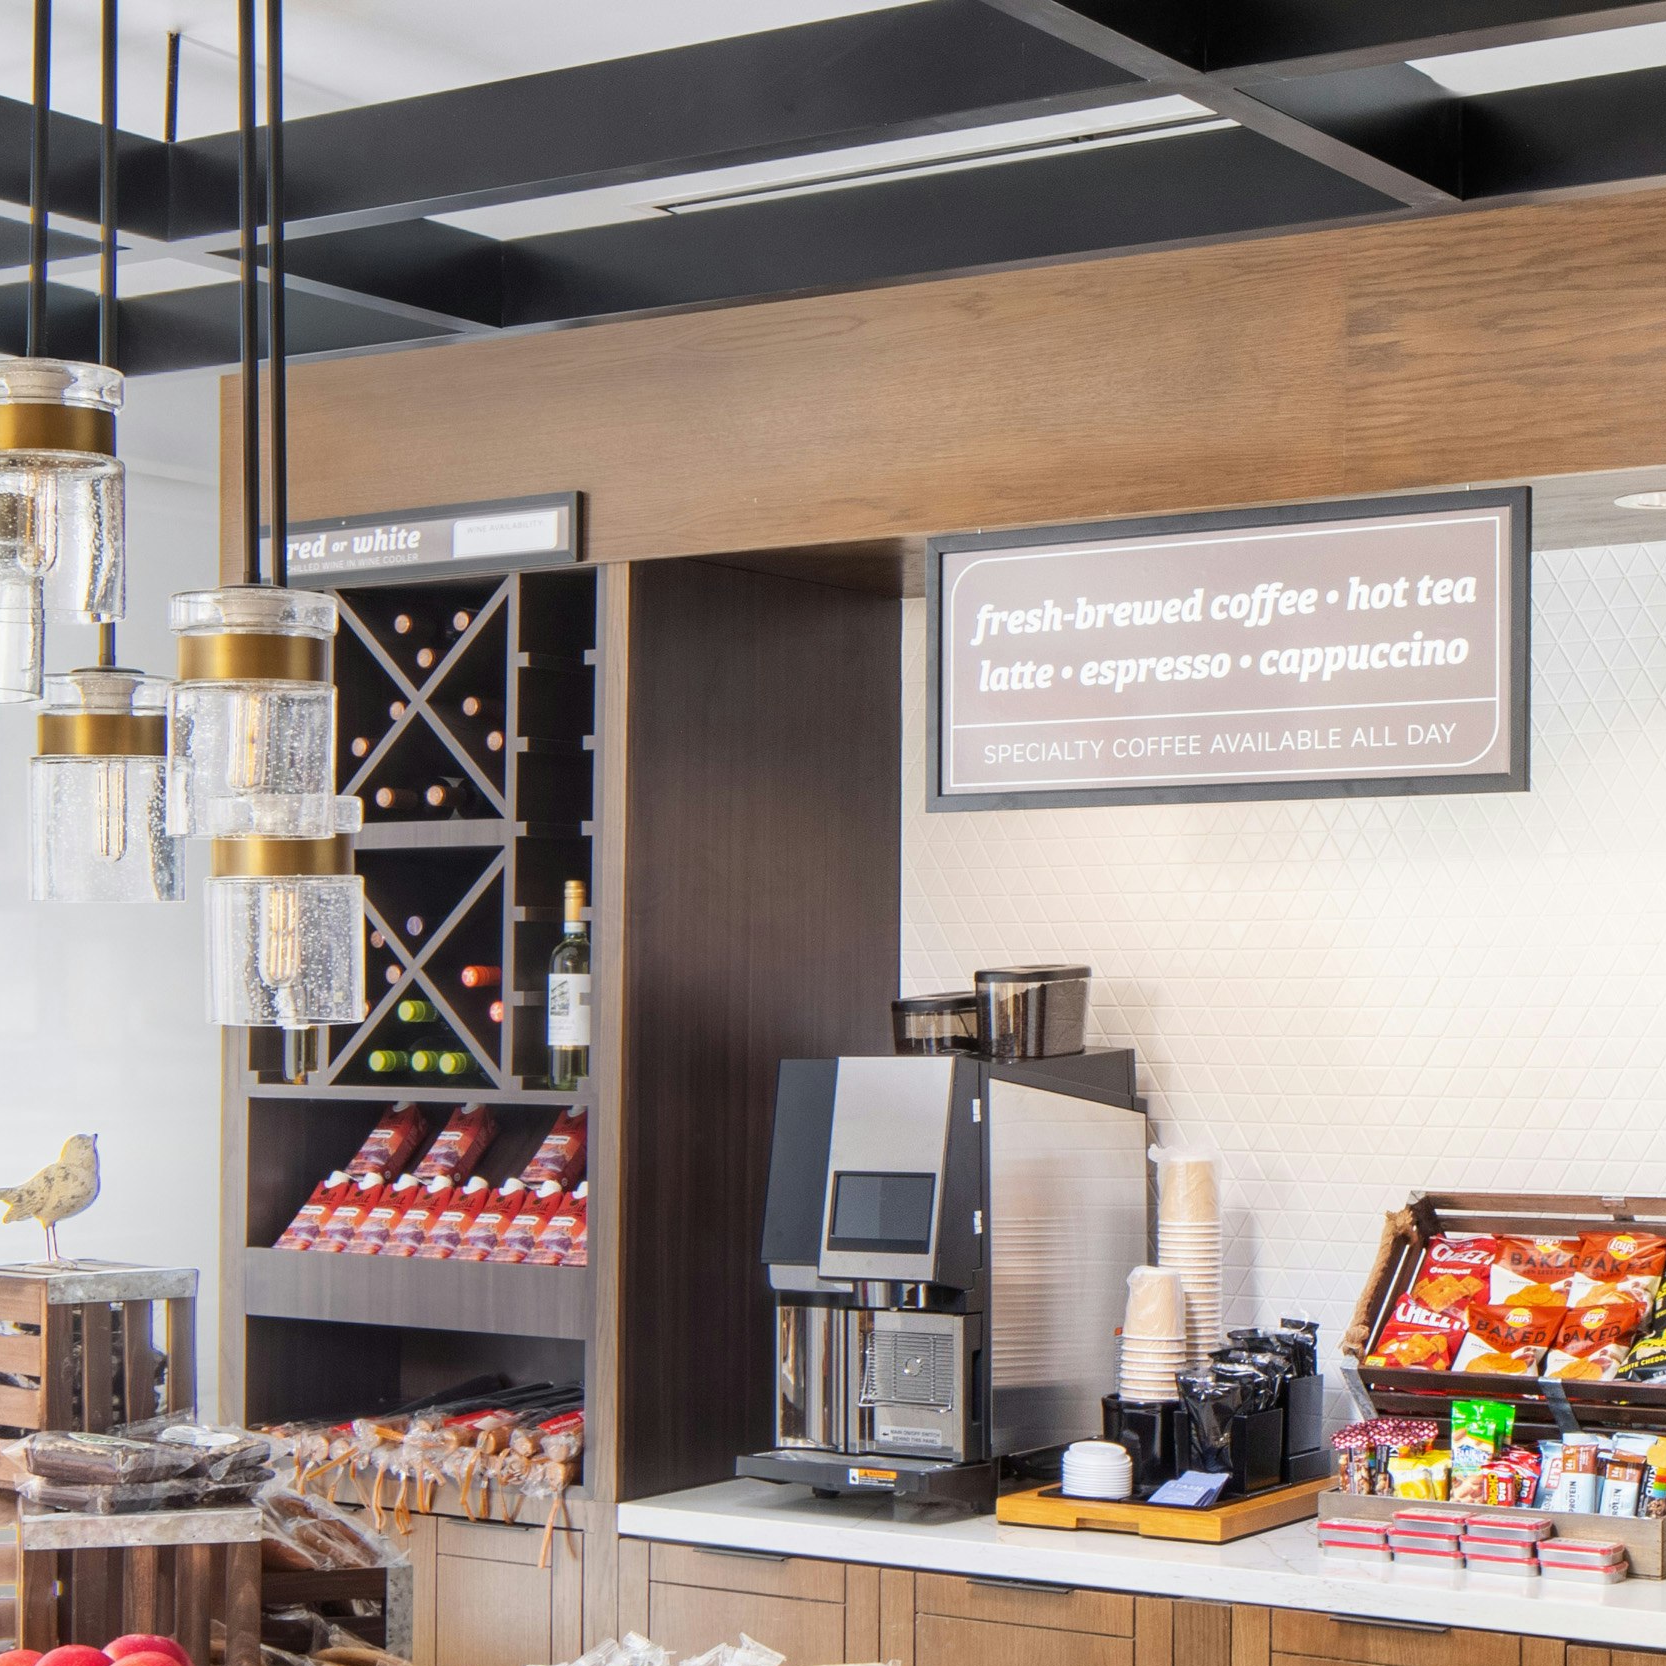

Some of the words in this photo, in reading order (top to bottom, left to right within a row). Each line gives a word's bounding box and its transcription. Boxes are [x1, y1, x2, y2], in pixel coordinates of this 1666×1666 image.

[286, 534, 325, 560] red
[332, 540, 348, 554] or
[354, 527, 421, 554] white
[323, 560, 344, 571] WINE
[346, 559, 355, 569] IN
[358, 556, 380, 569] WINE
[382, 553, 419, 565] COOLER
[971, 589, 1203, 646] fresh-brewed
[1211, 581, 1318, 628] coffee
[1347, 575, 1408, 612] hot
[1416, 575, 1477, 606] tea
[979, 659, 1053, 692] latte
[1079, 654, 1231, 693] espresso
[1259, 634, 1469, 683] cappuccino
[984, 740, 1102, 765] SPECIALTY
[1113, 734, 1201, 758] COFFEE
[1211, 728, 1342, 754] AVAILABLE
[1351, 725, 1397, 748] ALL
[1407, 723, 1456, 746] DAY
[1613, 1241, 1637, 1254] Lay's
[1475, 1322, 1547, 1344] BAKED
[1618, 1362, 1639, 1373] WHITE
[1498, 1481, 1506, 1502] BIG
[1569, 1480, 1577, 1513] PROTEIN
